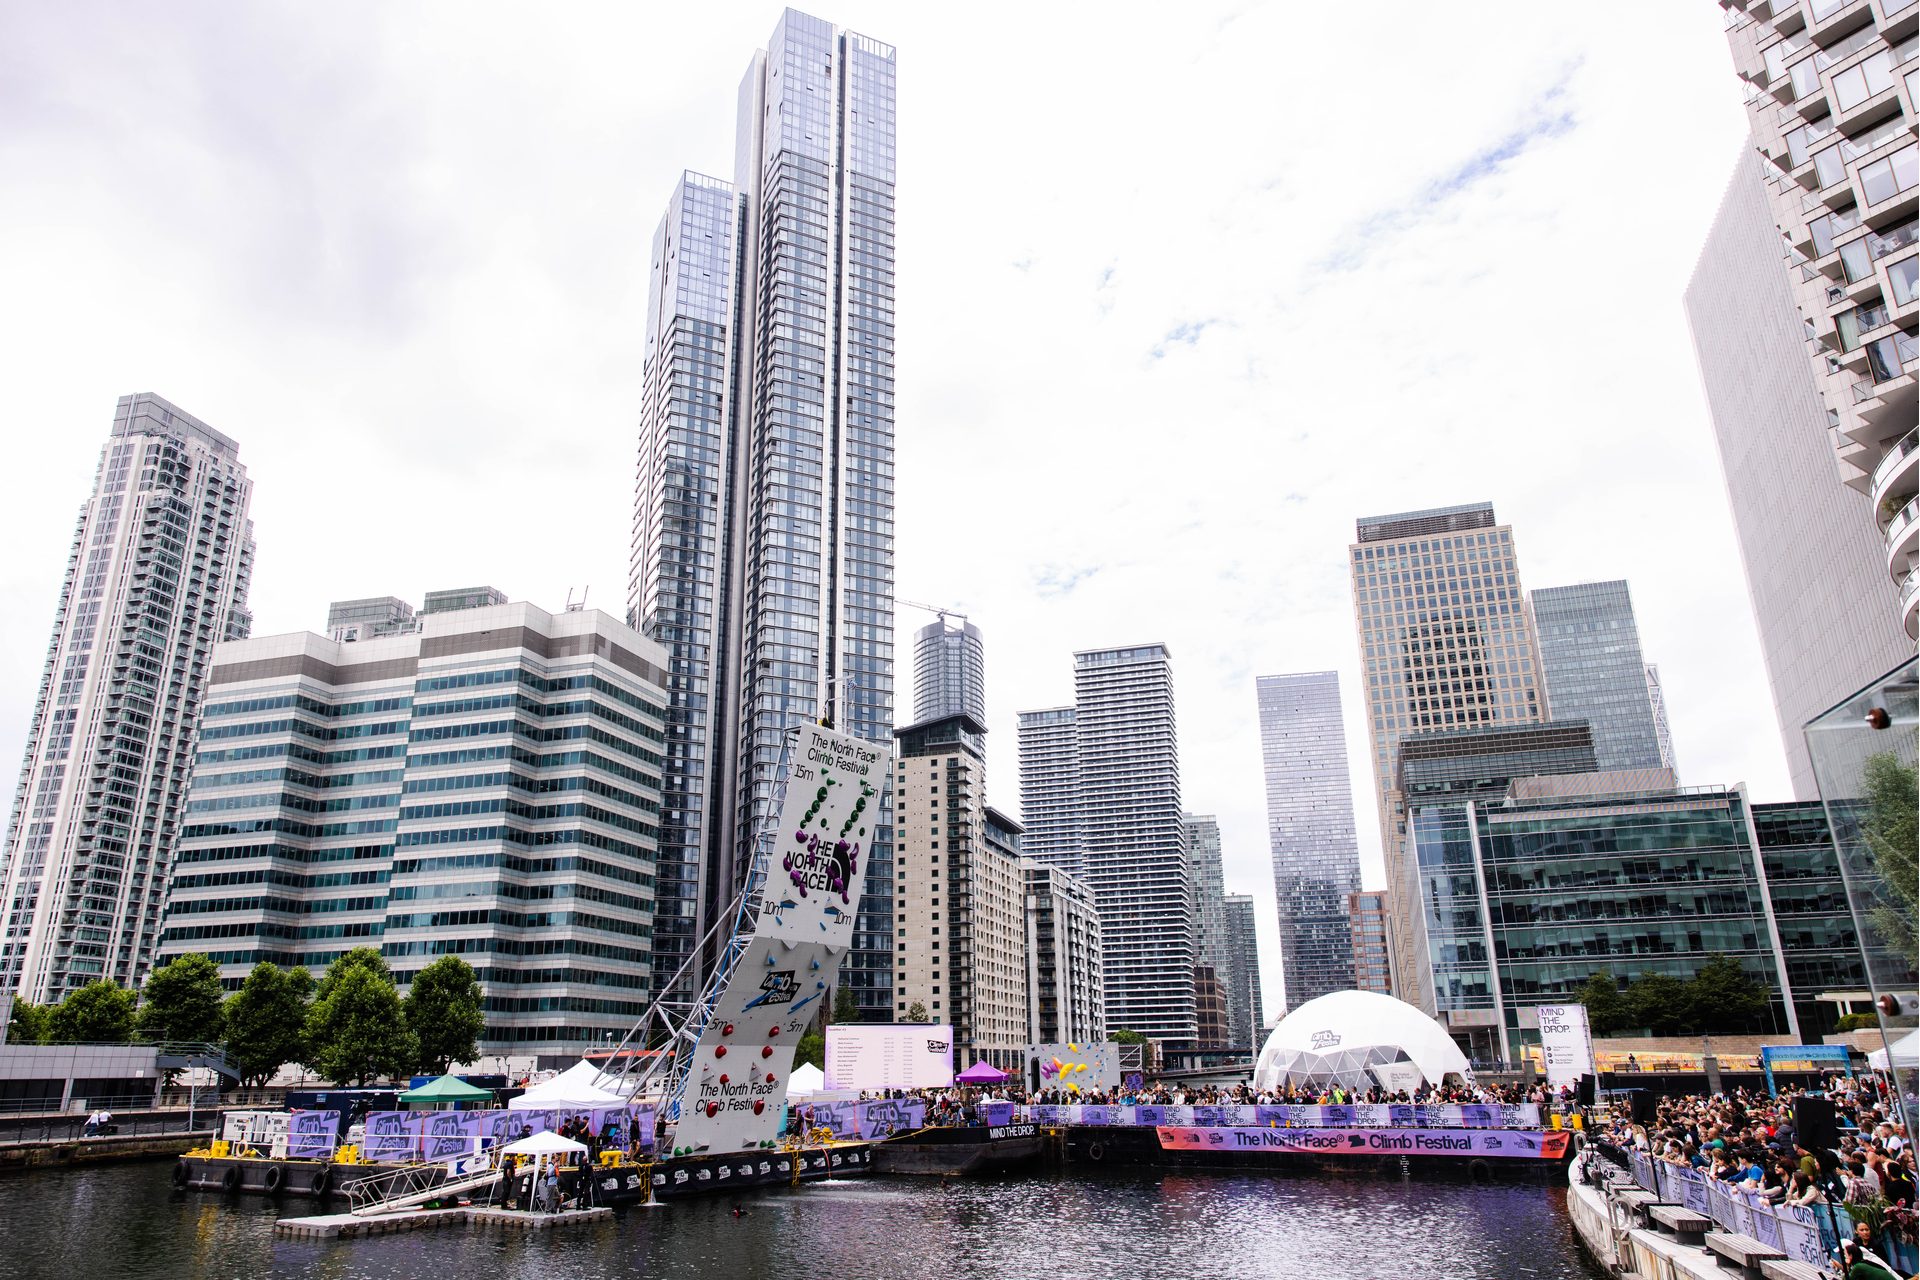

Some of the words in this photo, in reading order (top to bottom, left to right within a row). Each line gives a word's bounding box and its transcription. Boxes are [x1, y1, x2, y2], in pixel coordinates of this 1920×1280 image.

[812, 732, 828, 749] The
[830, 739, 854, 757] North
[808, 748, 834, 766] Climb
[835, 757, 869, 776] Festival
[794, 764, 814, 781] 15m
[809, 839, 833, 857] HE
[792, 871, 826, 890] ACE
[763, 901, 783, 916] 10m
[834, 911, 851, 925] 10m
[1541, 1008, 1565, 1016] MIND
[709, 1018, 727, 1030] 5m
[787, 1021, 803, 1032] 5m
[1544, 1025, 1570, 1033] DROP.
[700, 1083, 718, 1097] The
[721, 1083, 748, 1097] North
[868, 1104, 897, 1121] Climb
[989, 1128, 1006, 1139] MIND
[1006, 1126, 1018, 1137] THE
[1018, 1125, 1036, 1136] DROP.
[1234, 1132, 1260, 1146] The
[1263, 1133, 1301, 1147] North
[1369, 1134, 1412, 1149] Climb
[1416, 1135, 1472, 1150] Festival
